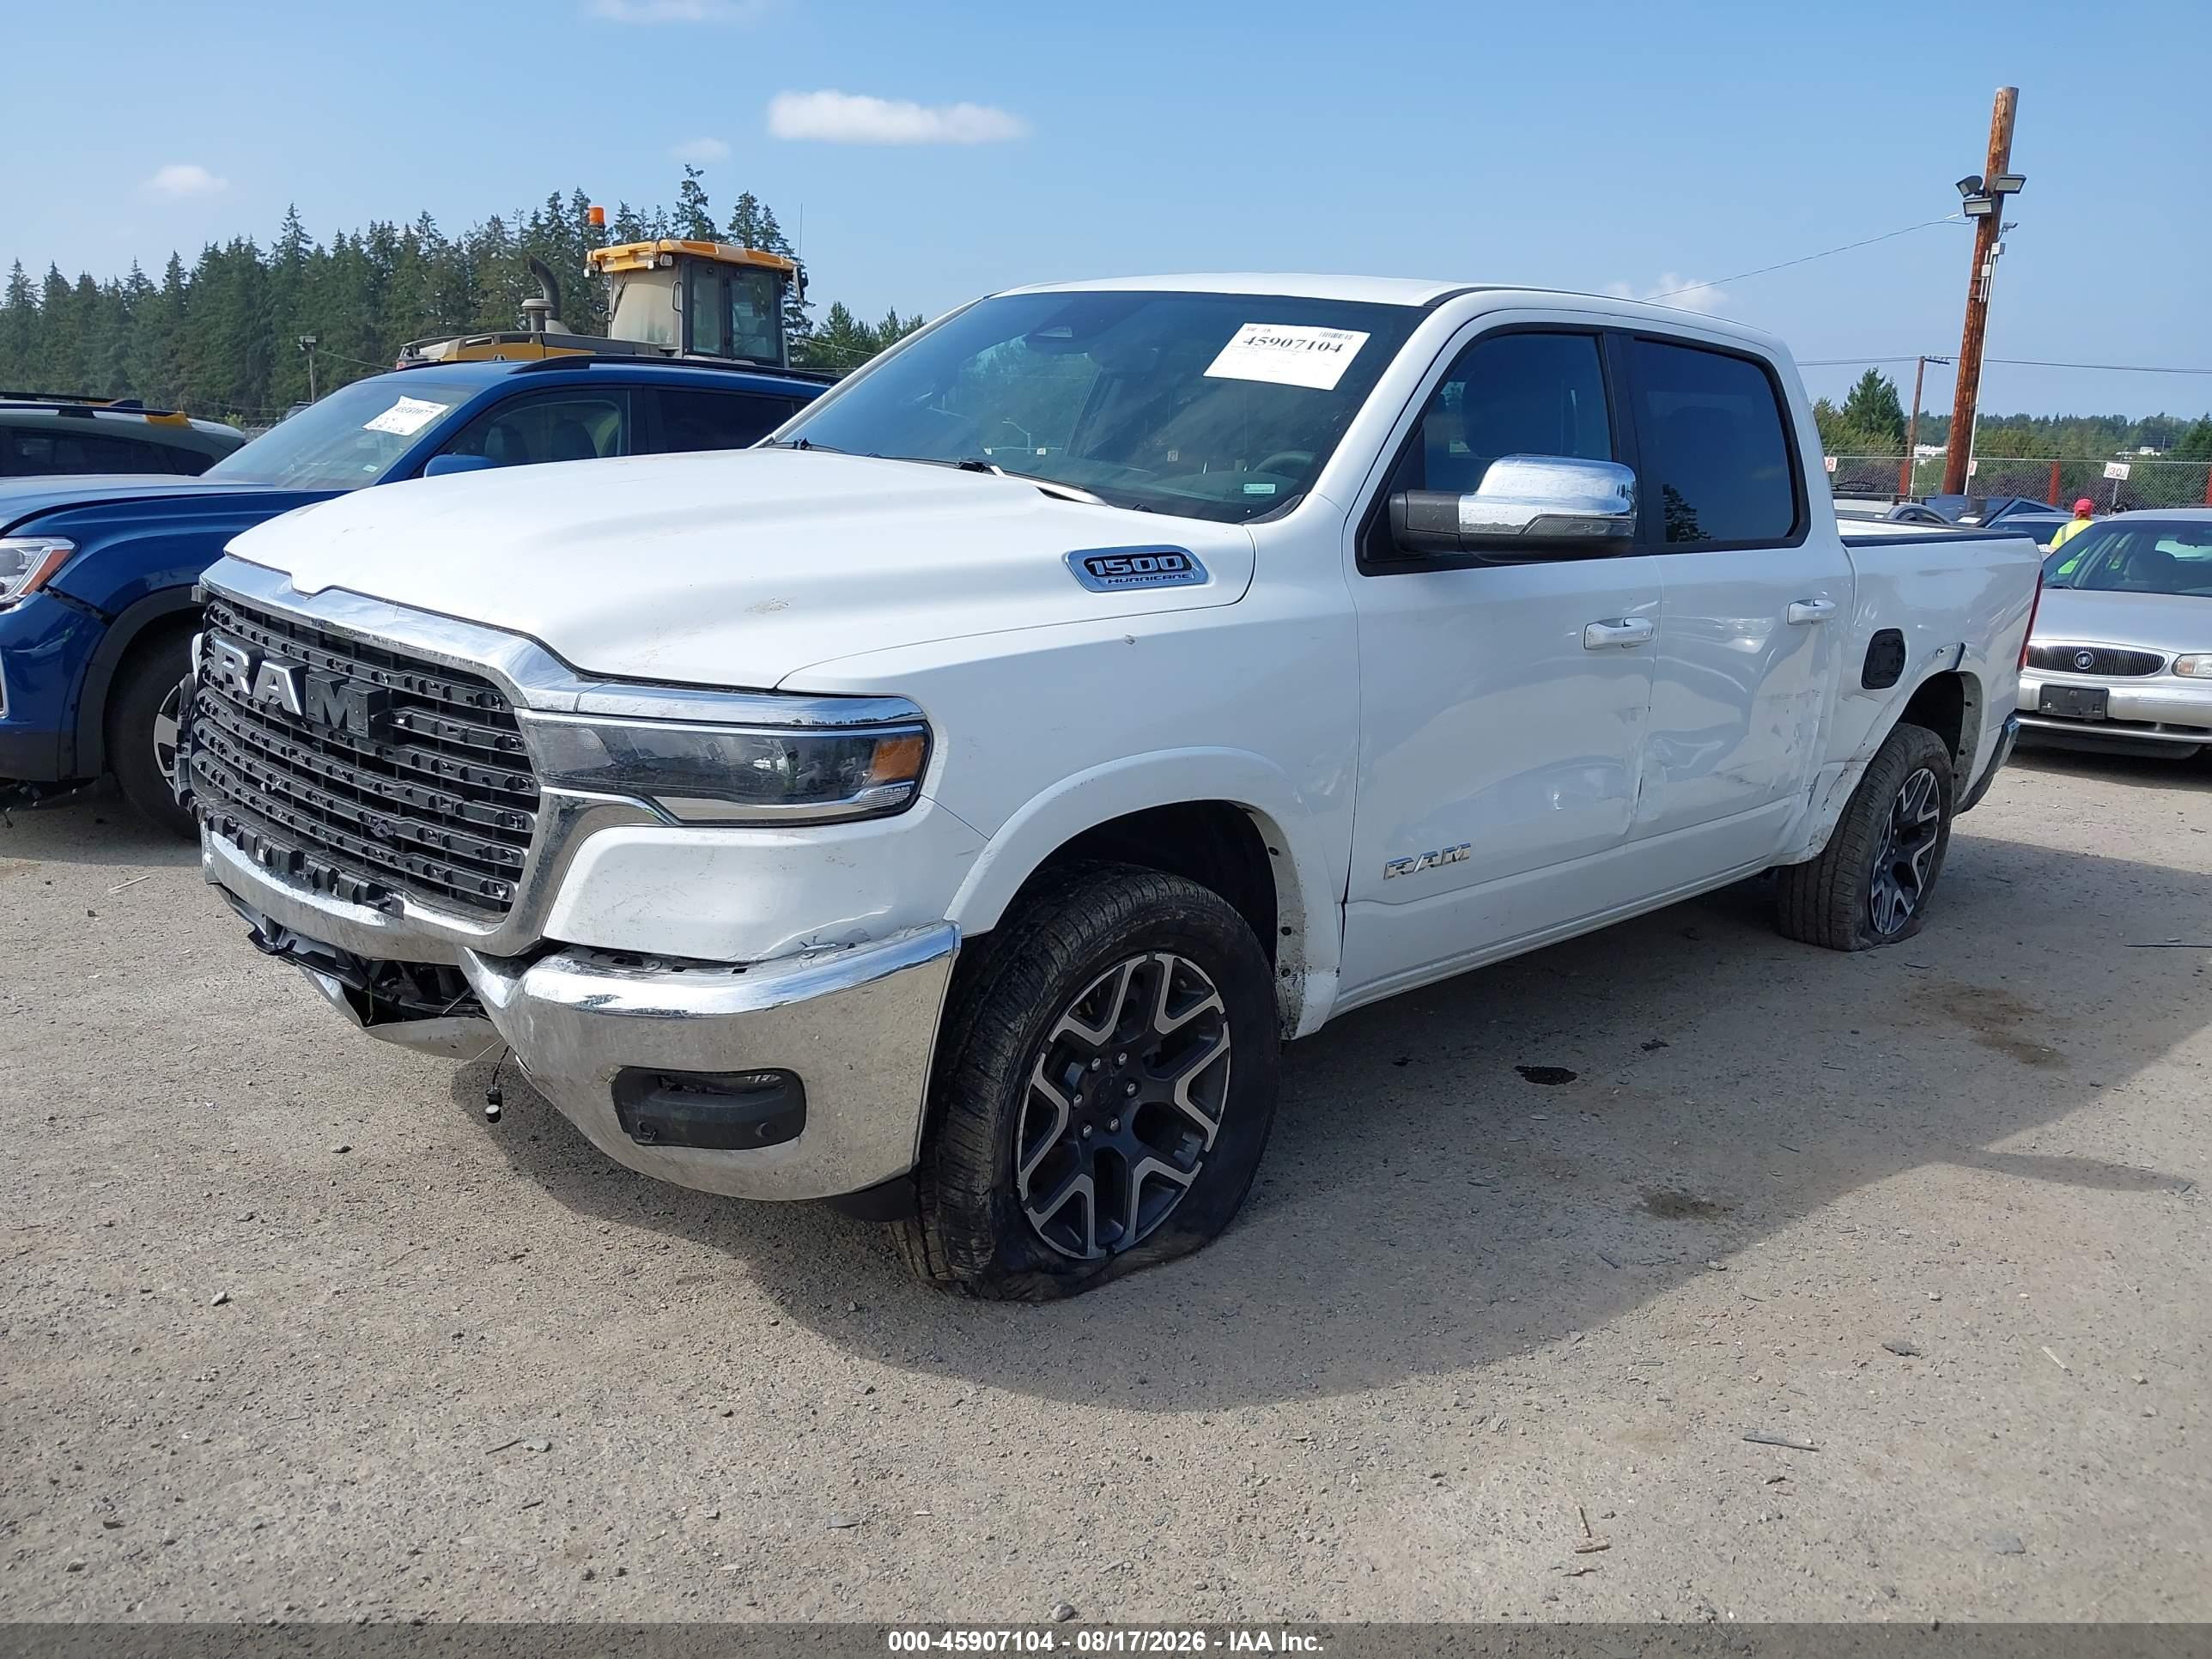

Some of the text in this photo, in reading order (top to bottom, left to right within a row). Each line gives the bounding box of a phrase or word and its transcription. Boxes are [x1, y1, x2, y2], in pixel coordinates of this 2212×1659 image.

[1243, 336, 1344, 353] 45907104
[1087, 555, 1185, 576] 1500
[213, 633, 383, 739] RAM
[1383, 842, 1472, 881] RAM
